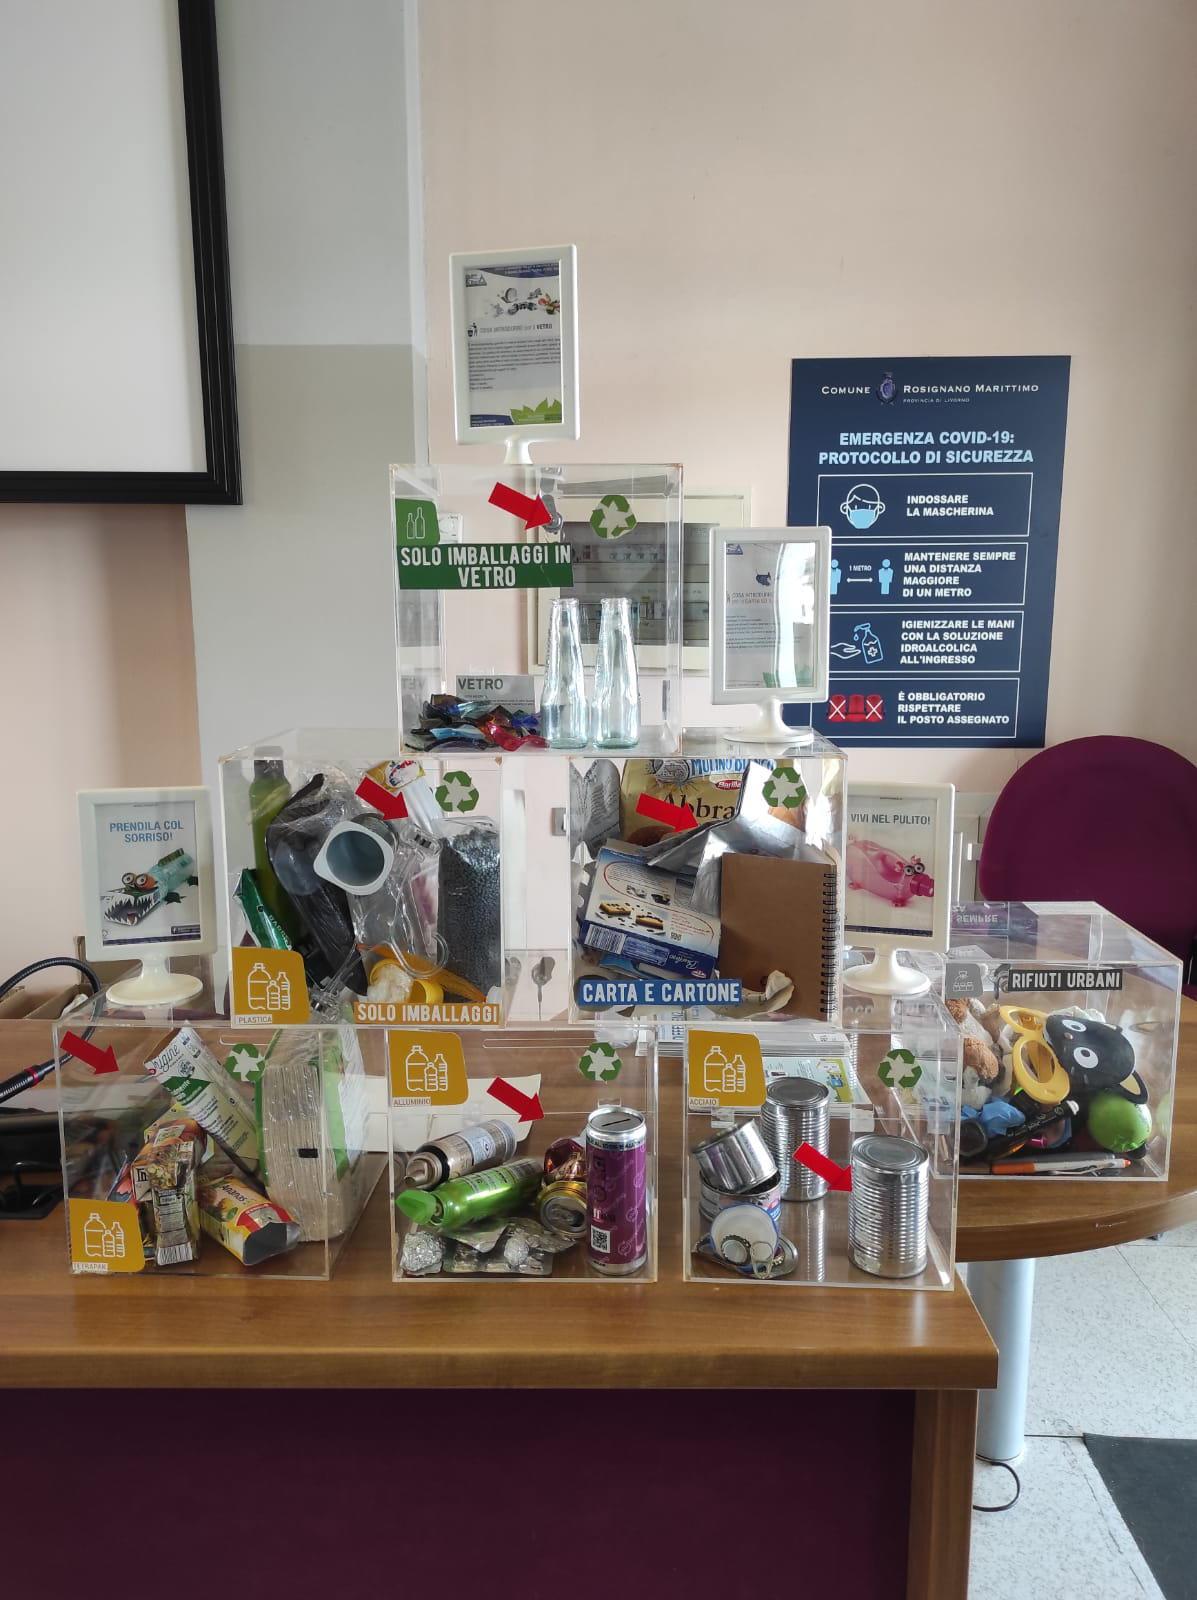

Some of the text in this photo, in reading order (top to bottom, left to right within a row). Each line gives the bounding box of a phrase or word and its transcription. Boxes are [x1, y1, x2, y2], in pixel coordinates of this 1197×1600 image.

[839, 431, 1015, 446] EMERGENZA COVID-19:
[818, 450, 1034, 465] PROTOCOLLO DI SICUREZZA
[907, 494, 969, 504] INDOSSARE
[906, 506, 994, 517] LA MASCHERINA
[400, 545, 571, 566] SOLO IMBALLAGGI IN
[904, 552, 1016, 562] MANTENERE SEMPRE
[904, 564, 982, 573] UNA DISTANZA
[458, 566, 516, 588] VETRO
[903, 576, 960, 585] MAGGIORE
[902, 588, 972, 597] DI UN METRO
[902, 620, 1015, 629] IGIENIZZARE LE MANI
[901, 631, 1003, 641] CON LA SOLUZIONE
[900, 643, 977, 653] IDROALCOLICA
[900, 655, 976, 665] ALL'INGRESSO
[458, 678, 504, 690] VETRO
[898, 691, 986, 702] È OBBLIGATORIO
[897, 704, 961, 713] RISPETTARE
[897, 715, 1010, 724] IL POSTO ASSEGNATO
[850, 813, 930, 825] VIVI NEL PULITO!
[109, 820, 184, 833] PRENDILA COL
[124, 832, 173, 843] SORRISO!
[1012, 972, 1120, 989] RIFIUTI URBANI
[582, 982, 740, 1003] CARTA E CARTONE
[357, 1003, 498, 1023] SOLO IMBALLAGGI
[238, 1016, 272, 1024] PLASTICA
[393, 1098, 431, 1106] ALLUMINIO
[689, 1098, 716, 1106] ACCIAIO
